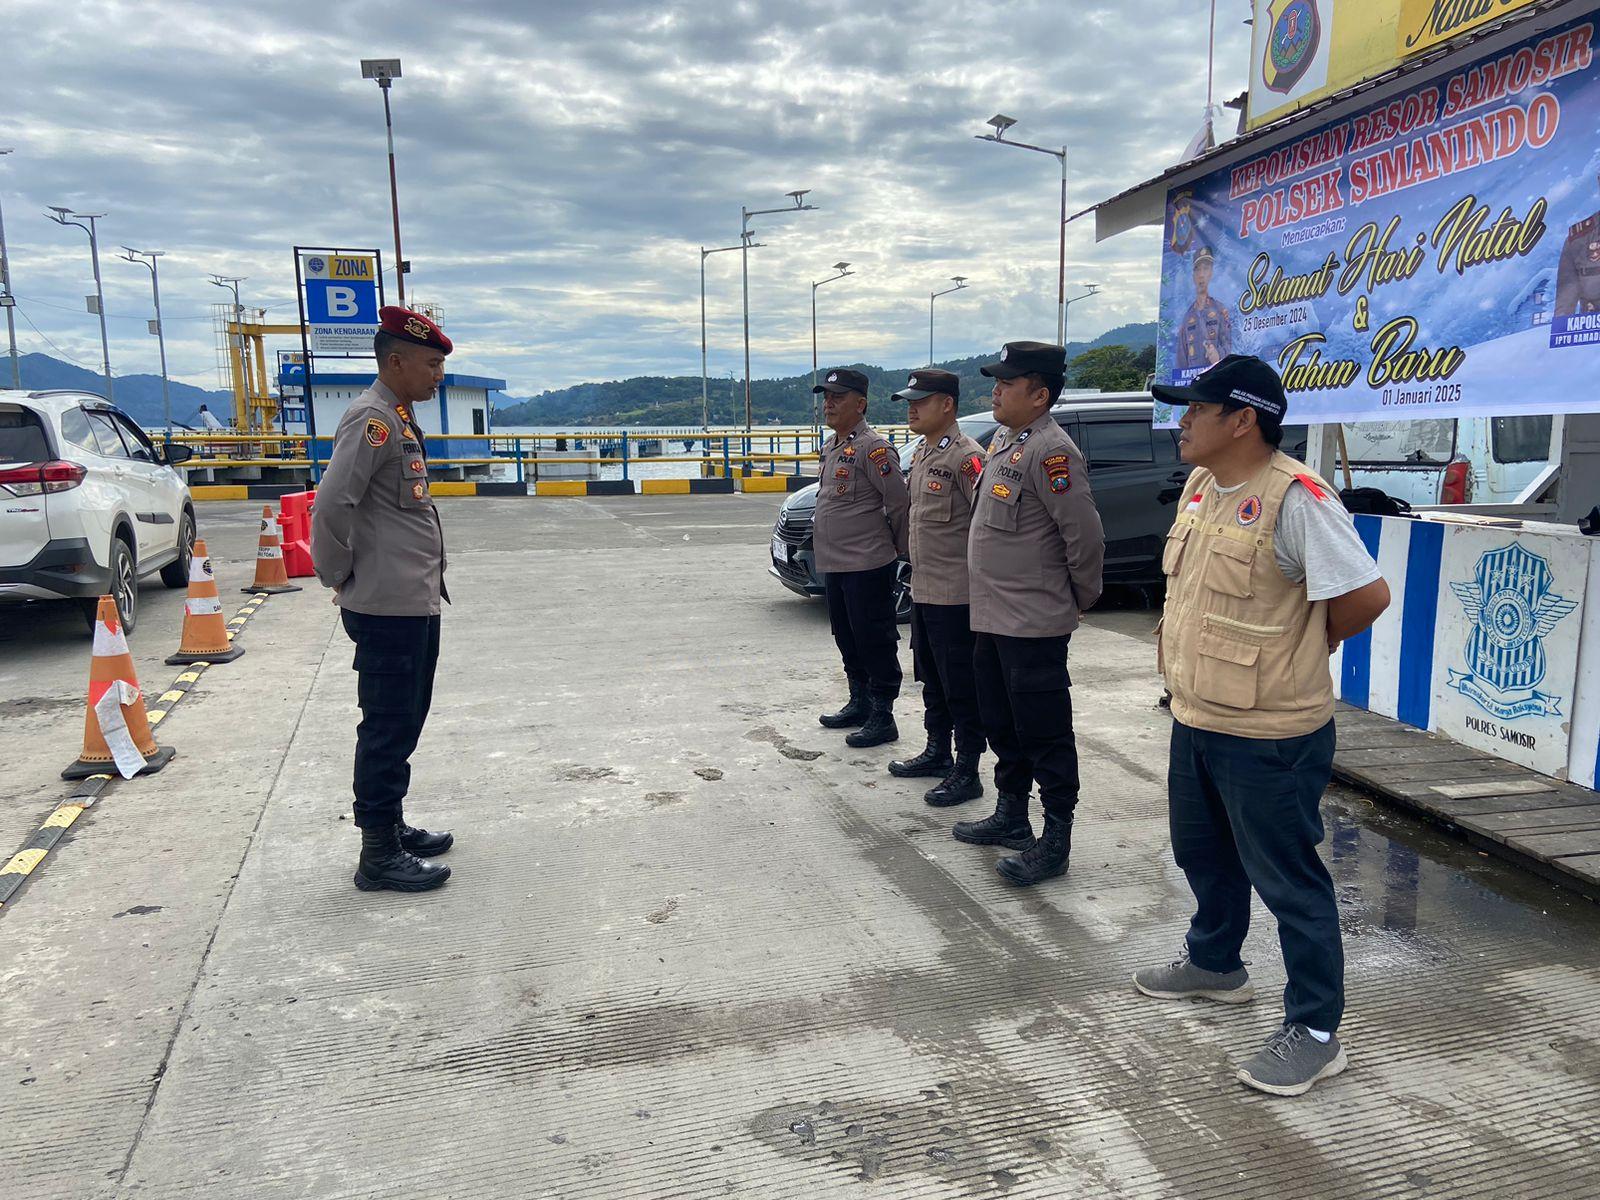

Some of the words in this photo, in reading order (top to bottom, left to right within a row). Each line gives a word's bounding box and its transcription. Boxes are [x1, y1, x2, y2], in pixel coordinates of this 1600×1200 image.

[1406, 0, 1494, 48] Naa
[1229, 124, 1349, 200] KEPOLISIAN
[1348, 87, 1439, 154] RESOR
[1442, 23, 1594, 120] SAMOSIR
[1240, 167, 1344, 239] POLSEK
[1349, 92, 1560, 205] SIMANINDO
[335, 259, 368, 276] ZONA
[1239, 252, 1340, 314] Selamat
[1338, 215, 1426, 297] Hari
[1431, 194, 1547, 276] Natal
[326, 286, 359, 317] B
[1353, 295, 1369, 332] &
[314, 327, 333, 335] ZONA
[334, 328, 376, 336] KENDARAAN
[1243, 318, 1252, 331] 25
[1254, 313, 1287, 330] Desember
[1290, 307, 1307, 323] 2024
[1573, 331, 1600, 343] RAMAD
[1278, 332, 1361, 393] Tahun
[1367, 315, 1466, 389] Baru
[1382, 390, 1392, 406] 01
[1394, 386, 1432, 405] Januari
[1435, 383, 1462, 402] 2025
[838, 455, 856, 465] POLRI
[928, 467, 952, 479] POLRI
[997, 465, 1022, 481] POLRI
[1465, 715, 1497, 737] POLRES
[1500, 726, 1536, 751] SAMOSIR
